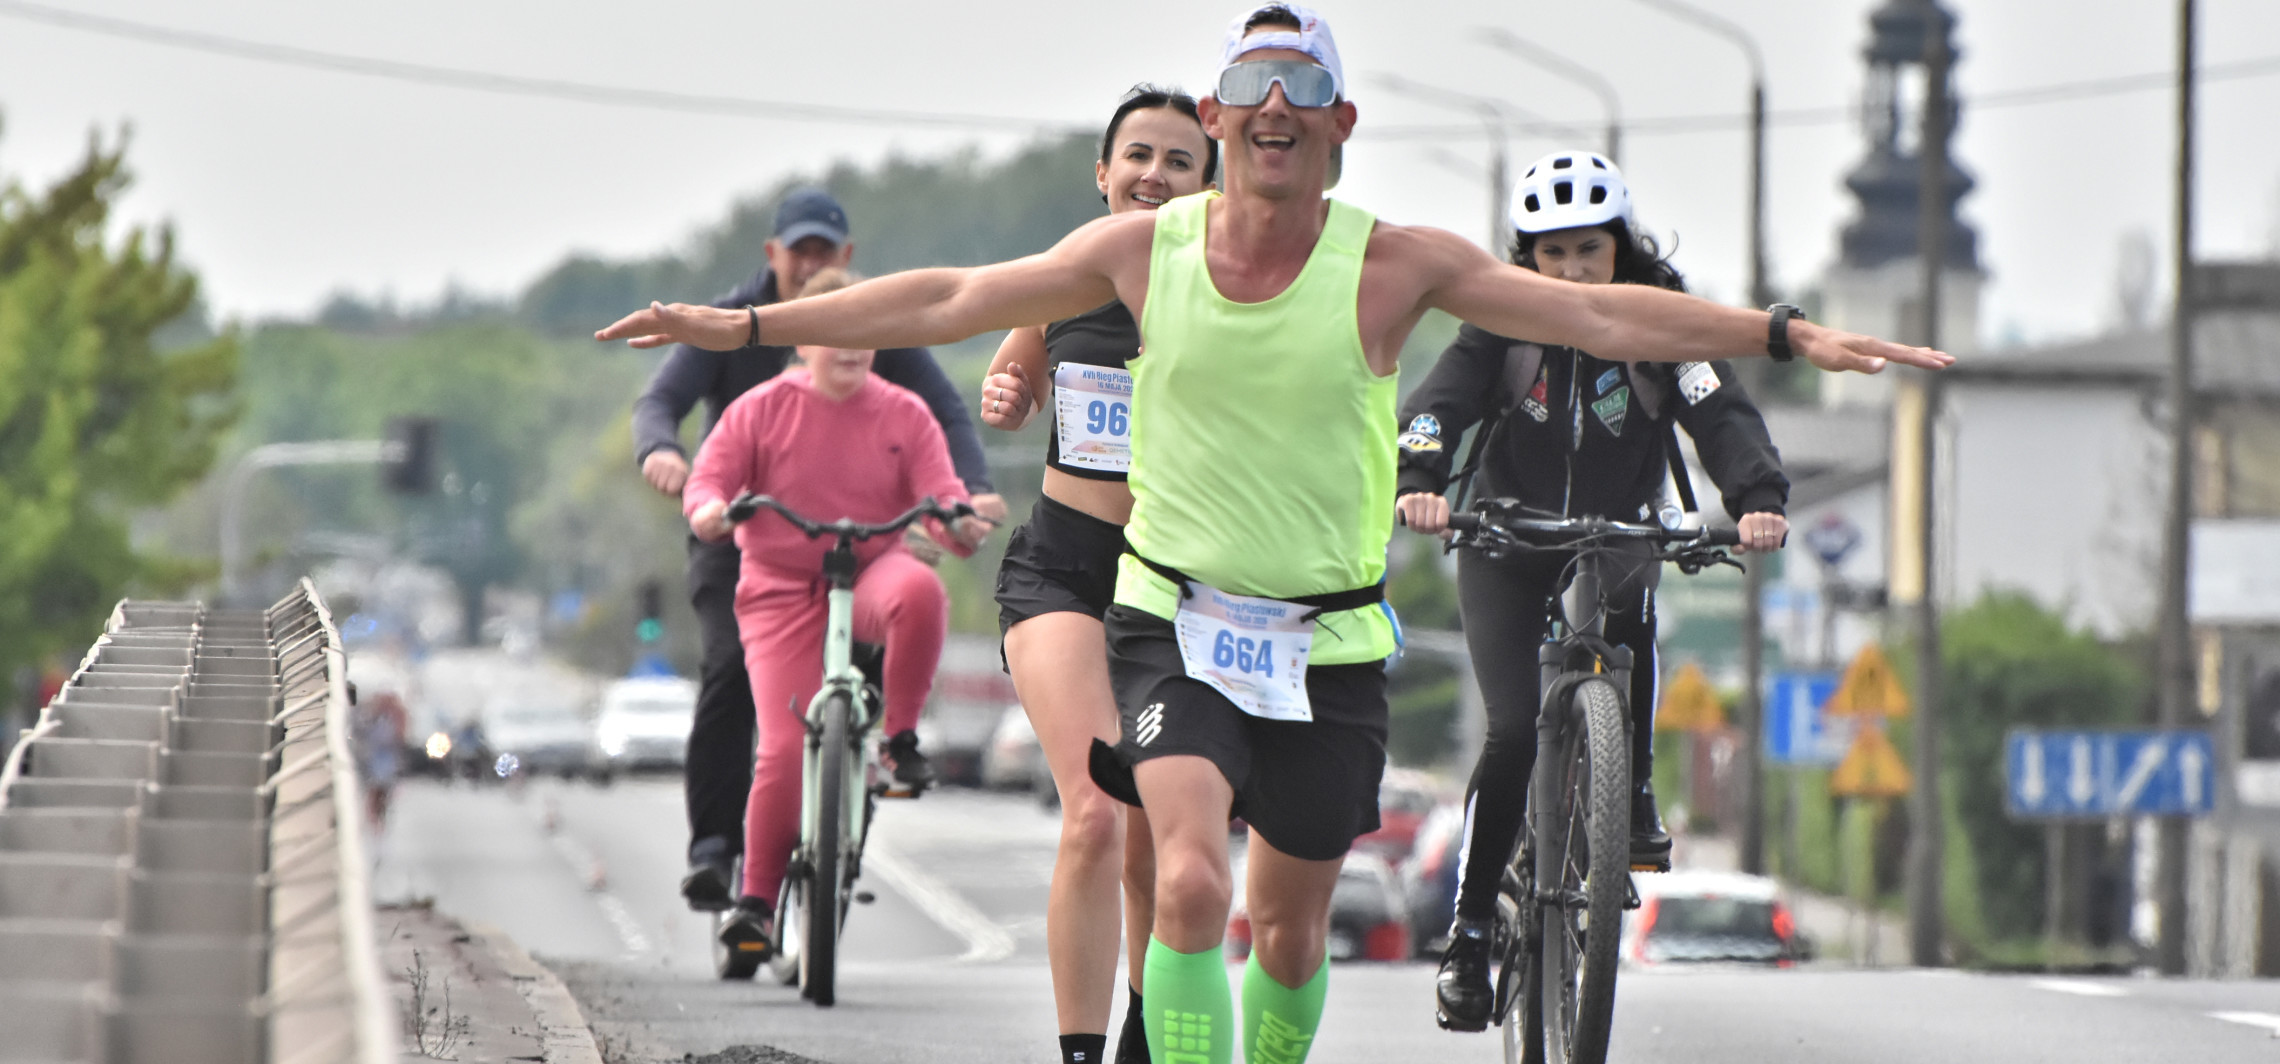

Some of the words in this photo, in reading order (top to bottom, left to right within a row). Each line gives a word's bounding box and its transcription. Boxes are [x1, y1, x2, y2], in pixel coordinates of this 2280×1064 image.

[1097, 371, 1112, 382] Bieg
[1105, 382, 1122, 391] MAJA
[1087, 400, 1131, 436] 96
[1213, 629, 1273, 678] 664
